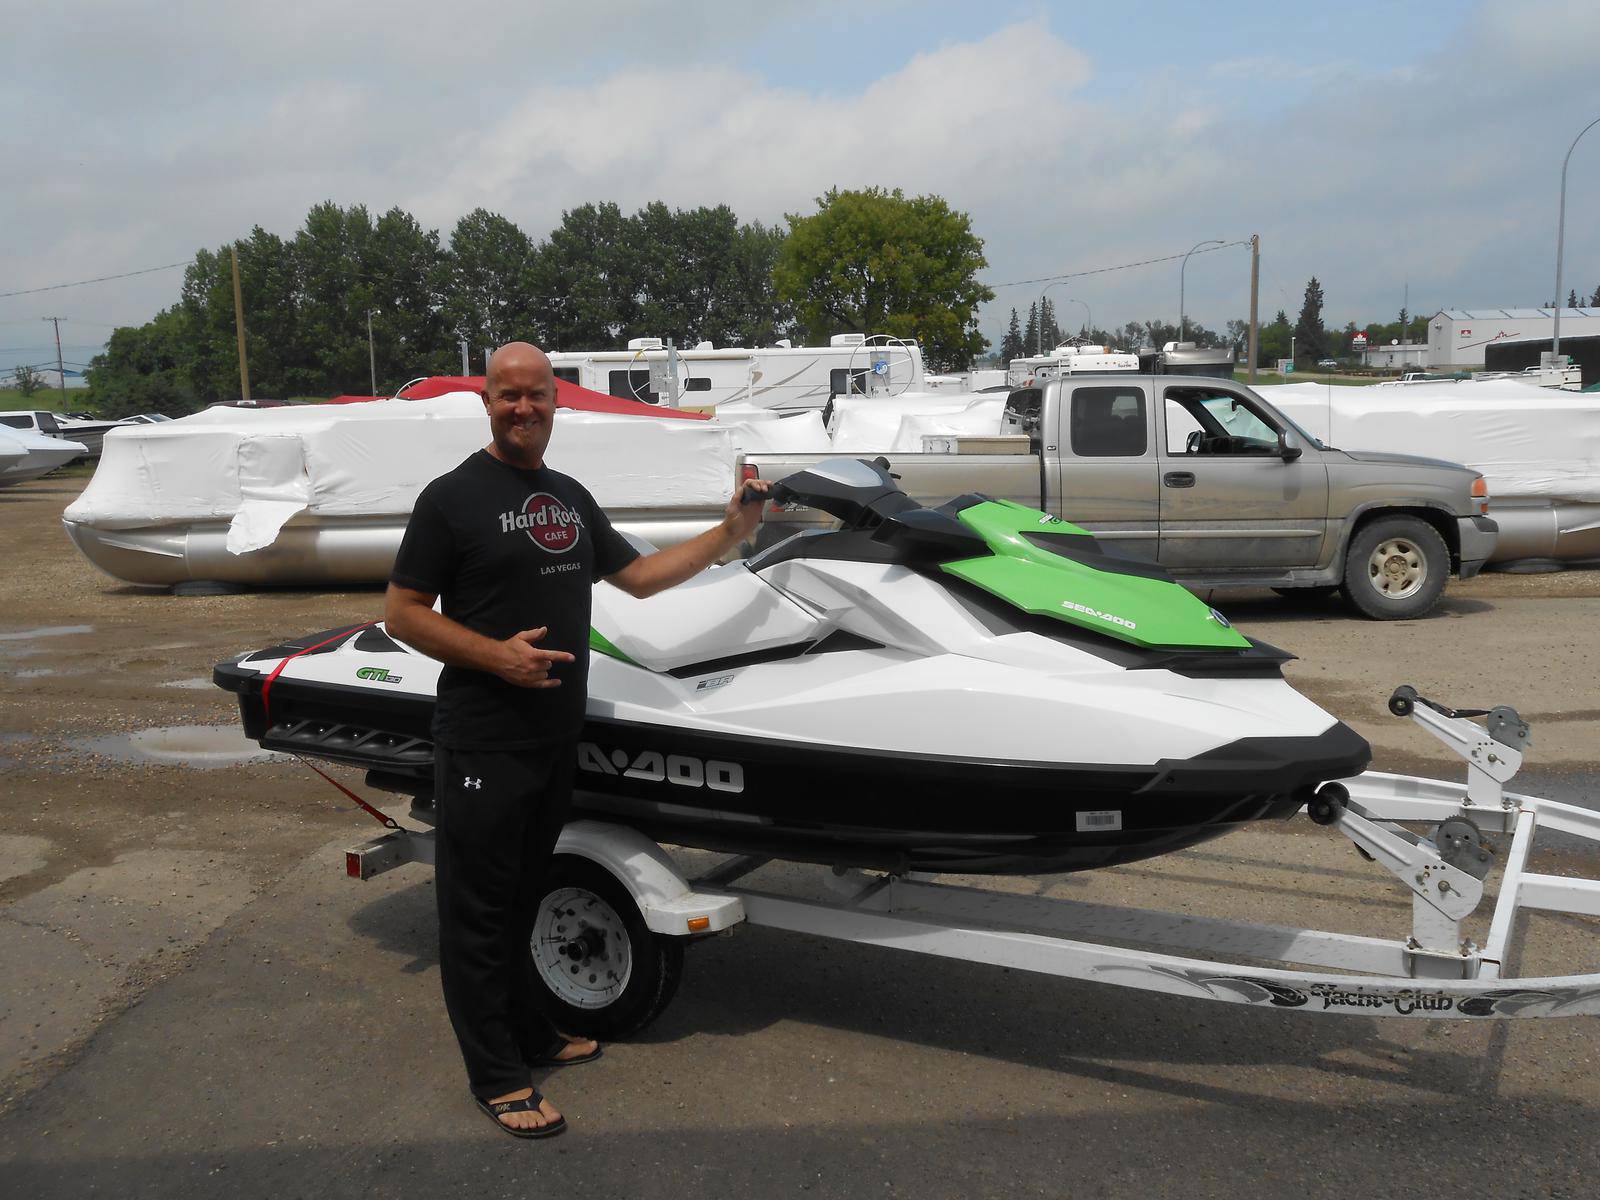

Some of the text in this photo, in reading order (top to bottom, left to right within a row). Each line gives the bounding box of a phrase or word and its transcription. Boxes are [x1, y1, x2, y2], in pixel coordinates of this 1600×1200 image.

[499, 504, 585, 532] Hard Rock
[544, 530, 569, 541] CAFE
[540, 562, 581, 575] LAS VEGAS
[1394, 988, 1453, 1015] Club
